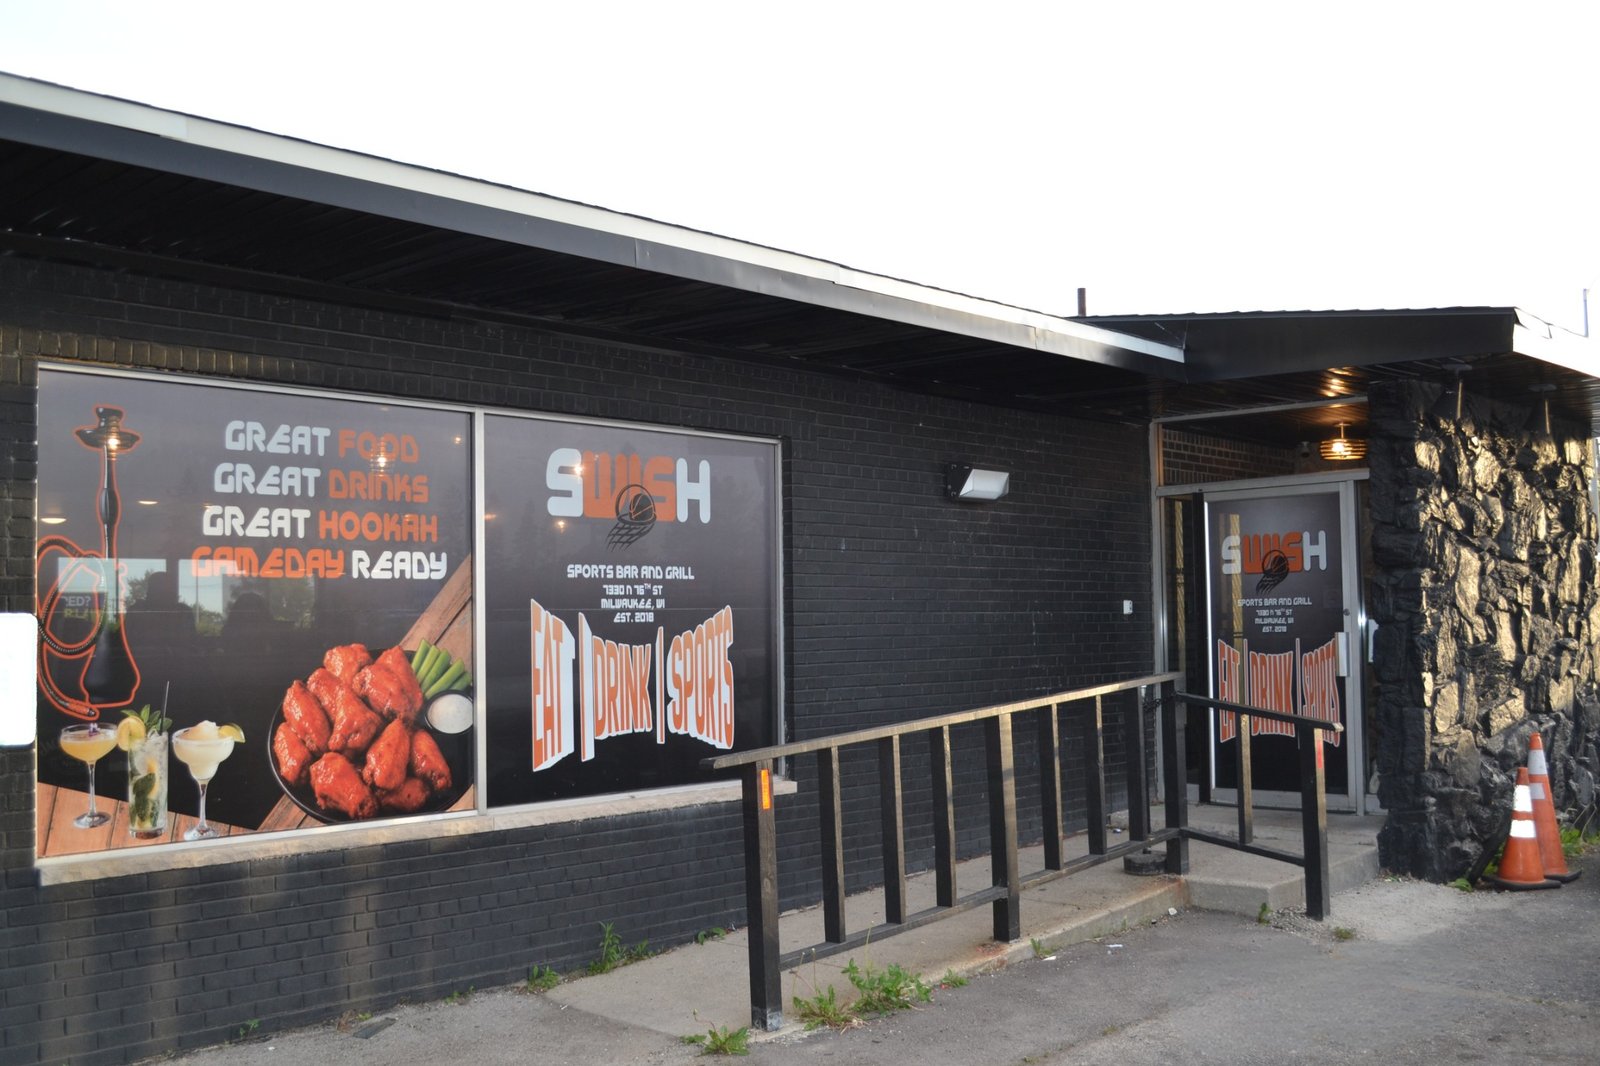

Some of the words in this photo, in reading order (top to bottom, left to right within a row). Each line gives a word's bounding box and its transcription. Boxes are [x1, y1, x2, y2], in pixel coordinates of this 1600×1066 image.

[225, 420, 331, 456] GREAT
[338, 429, 419, 463] FOOD
[214, 462, 321, 497] GREAT
[329, 469, 429, 503] DRINKS
[546, 448, 711, 524] SWISH
[202, 505, 311, 538] GREAT
[319, 510, 438, 543] HOOKAH
[191, 546, 345, 579] GAMEDAY
[352, 550, 447, 580] READY
[1221, 530, 1327, 575] SWISH
[567, 564, 614, 579] SPORTS
[616, 565, 639, 579] BAR
[641, 566, 663, 580] AND
[665, 566, 695, 580] GRILL
[603, 584, 625, 596] 7330
[652, 585, 663, 596] ST
[600, 598, 655, 611] MILWAUKEE,
[656, 598, 666, 609] WI
[613, 612, 634, 623] EST.
[634, 612, 655, 623] 2018
[1237, 598, 1263, 607] SPORTS
[1263, 598, 1278, 606] BAR
[1293, 597, 1313, 606] GRILL
[531, 598, 576, 772] EAT
[592, 635, 653, 740] DRINK
[667, 604, 735, 750] SPORTS
[1218, 638, 1241, 743] EAT
[1250, 651, 1296, 738] DRINK
